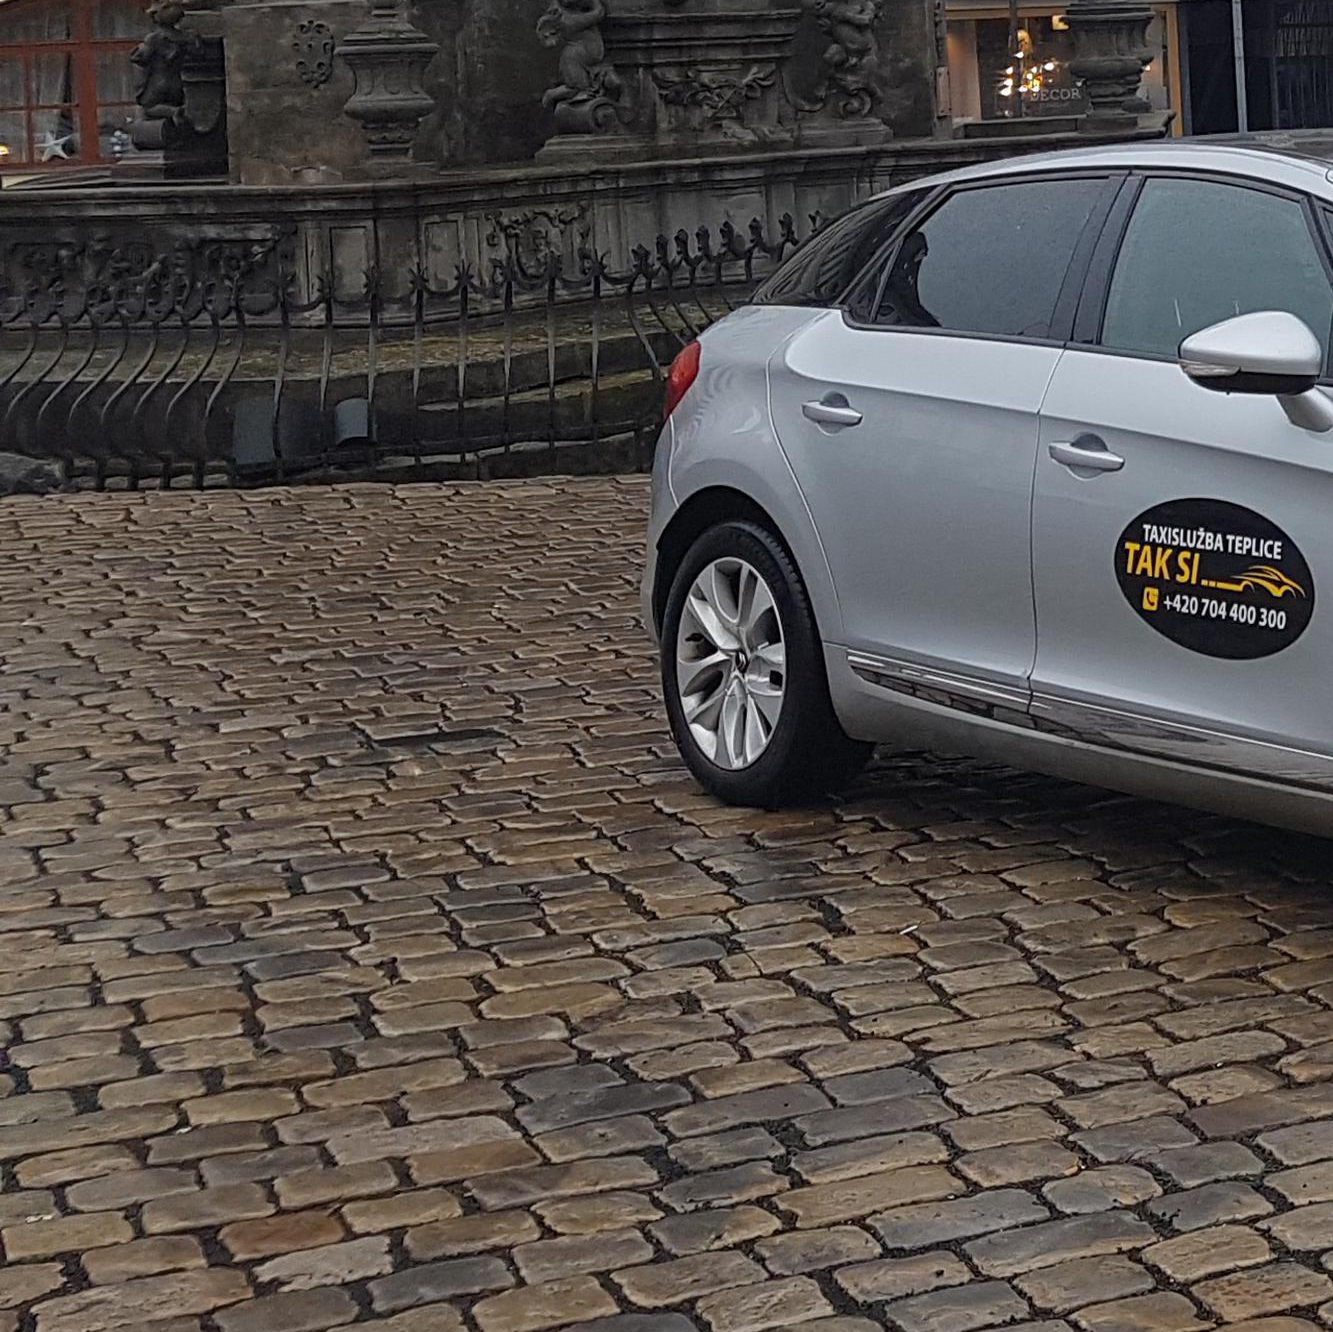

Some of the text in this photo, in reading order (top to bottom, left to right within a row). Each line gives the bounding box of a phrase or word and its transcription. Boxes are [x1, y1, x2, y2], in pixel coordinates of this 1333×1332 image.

[1030, 88, 1081, 101] DECOR
[1143, 524, 1283, 560] TAXISLUŽBA TEPLICE
[1124, 542, 1173, 580] TAK
[1164, 594, 1287, 630] +420 704 400 300
